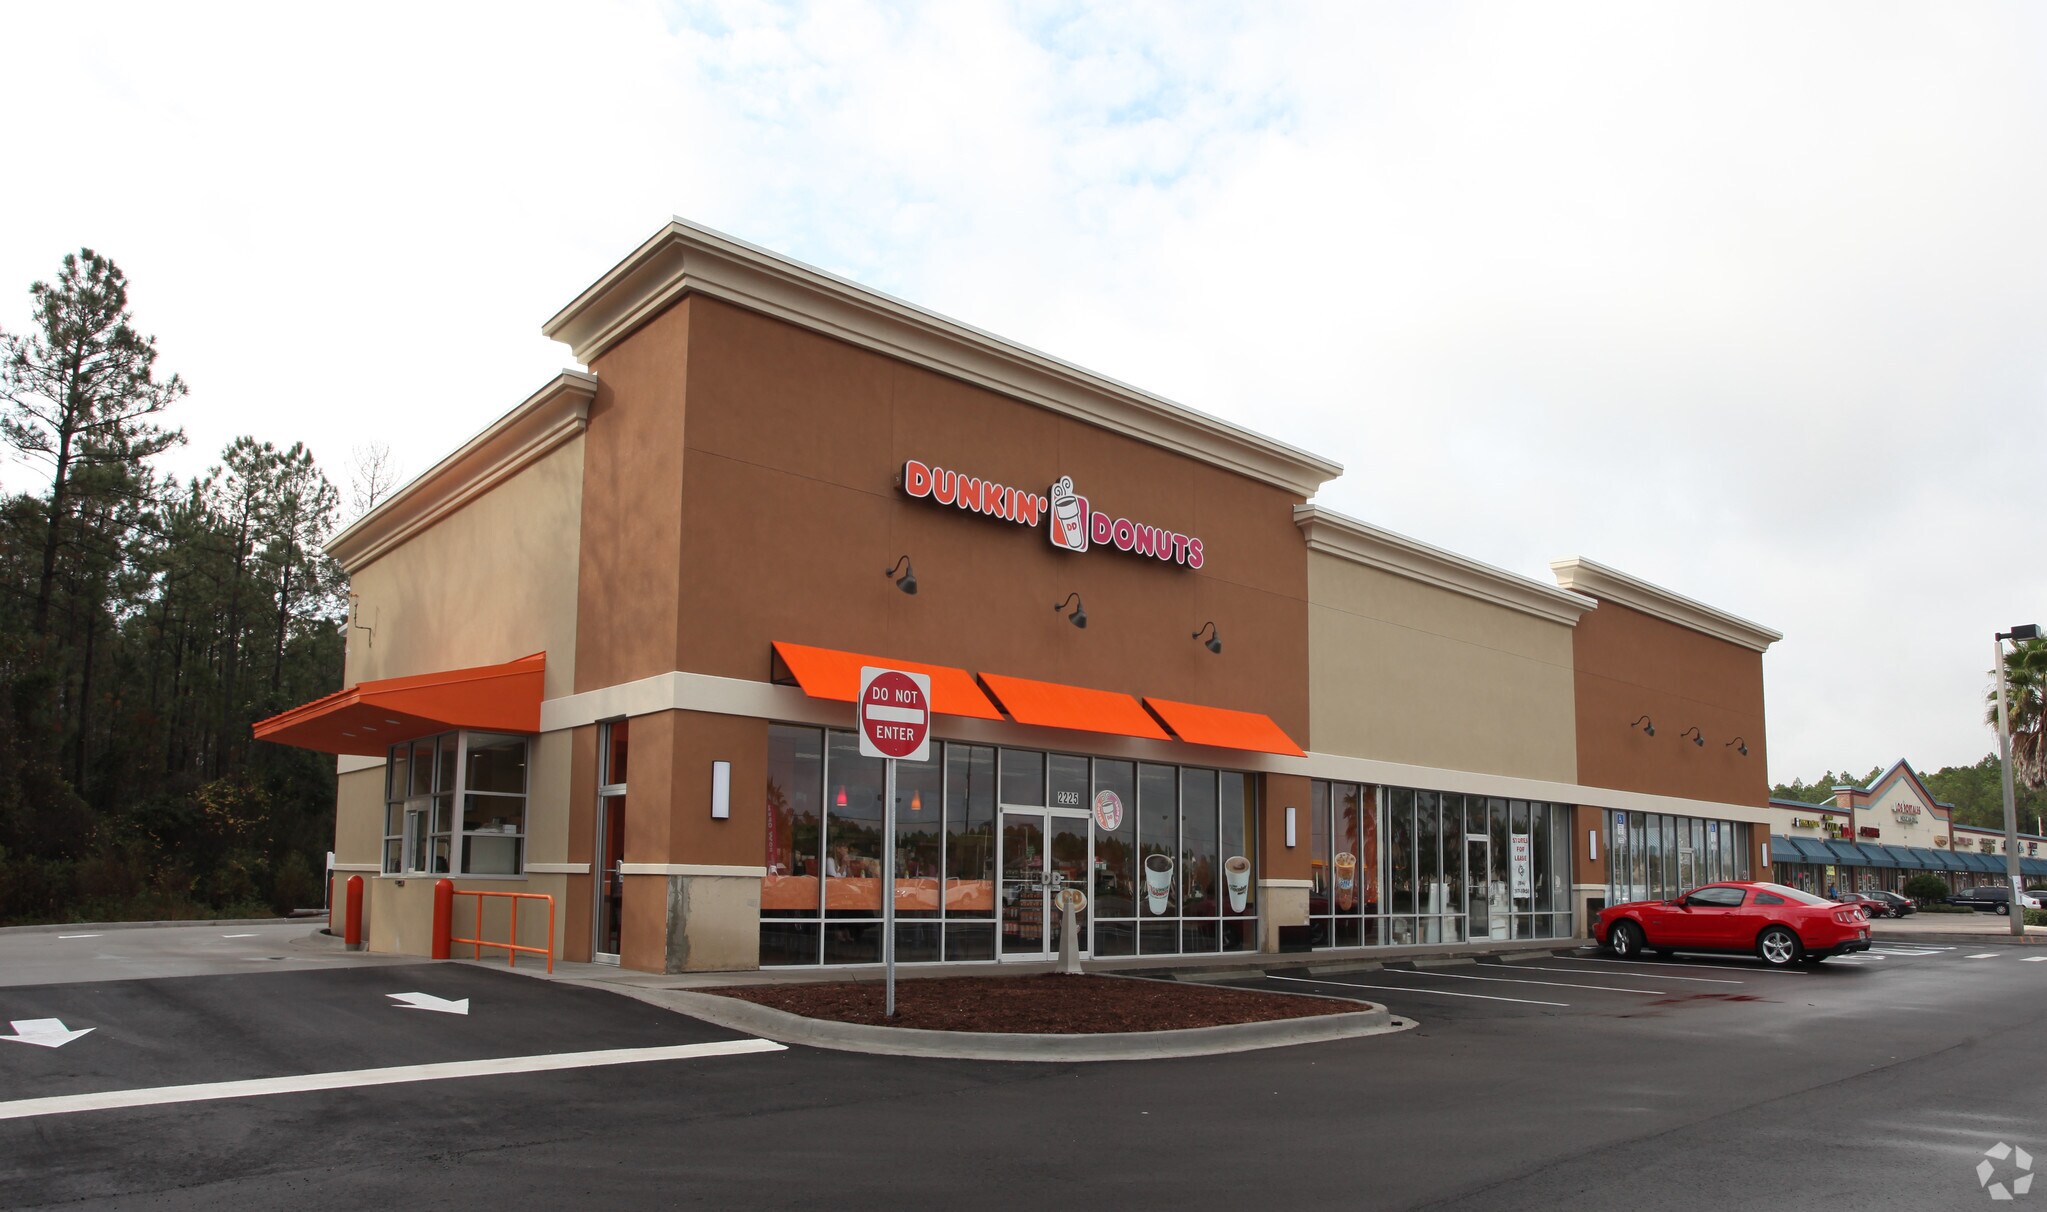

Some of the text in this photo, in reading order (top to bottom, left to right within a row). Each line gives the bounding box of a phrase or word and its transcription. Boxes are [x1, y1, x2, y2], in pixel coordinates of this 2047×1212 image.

[905, 459, 1204, 570] DUNKIN' DONUTS
[1066, 521, 1078, 532] DD
[872, 686, 918, 704] DO NOT
[876, 725, 914, 741] ENTER
[1058, 791, 1078, 804] 2225
